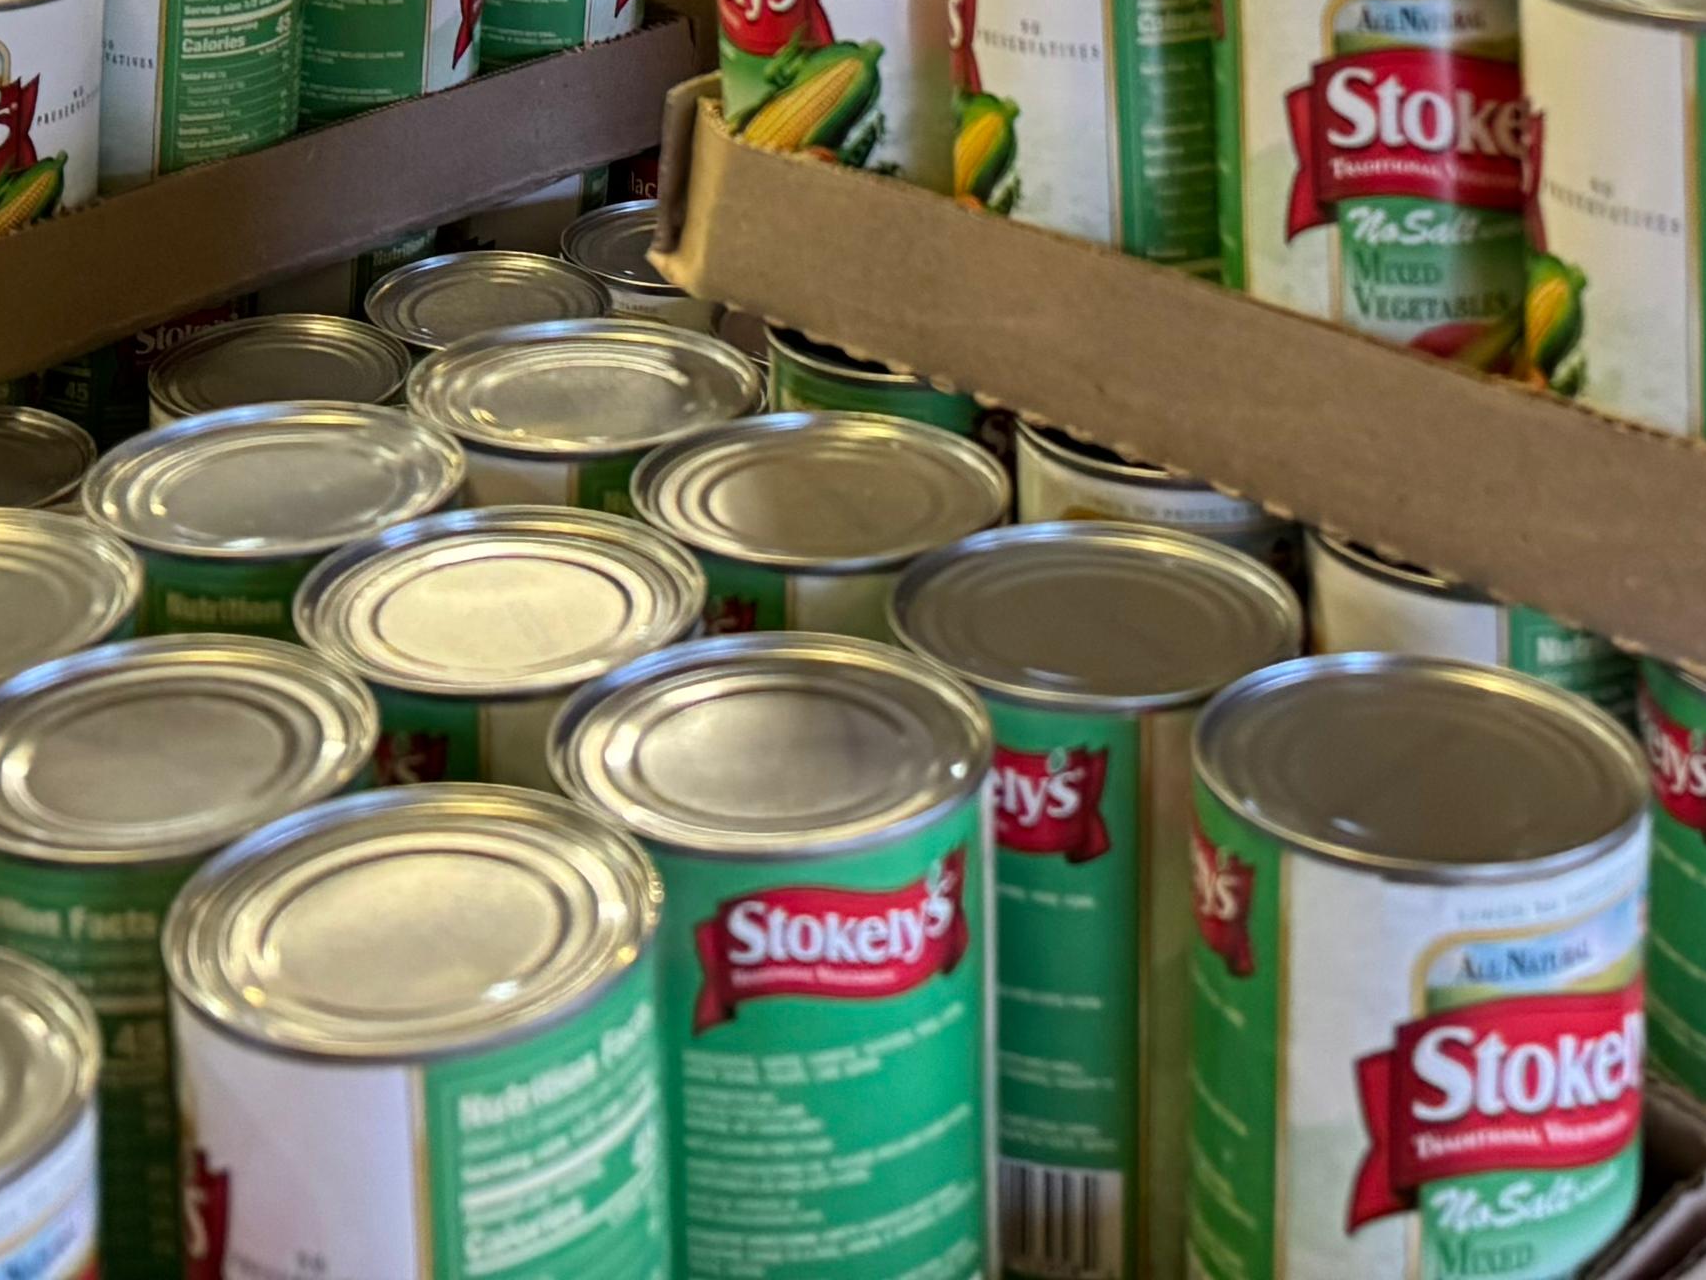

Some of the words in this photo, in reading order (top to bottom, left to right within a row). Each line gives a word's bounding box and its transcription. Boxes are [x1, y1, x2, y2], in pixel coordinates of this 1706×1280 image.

[182, 34, 246, 54] Calories
[1326, 65, 1531, 156] Stoke
[1353, 246, 1443, 284] MIXED
[67, 904, 158, 938] Facts
[726, 888, 953, 967] Stokely's
[1435, 1237, 1534, 1278] MIXED
